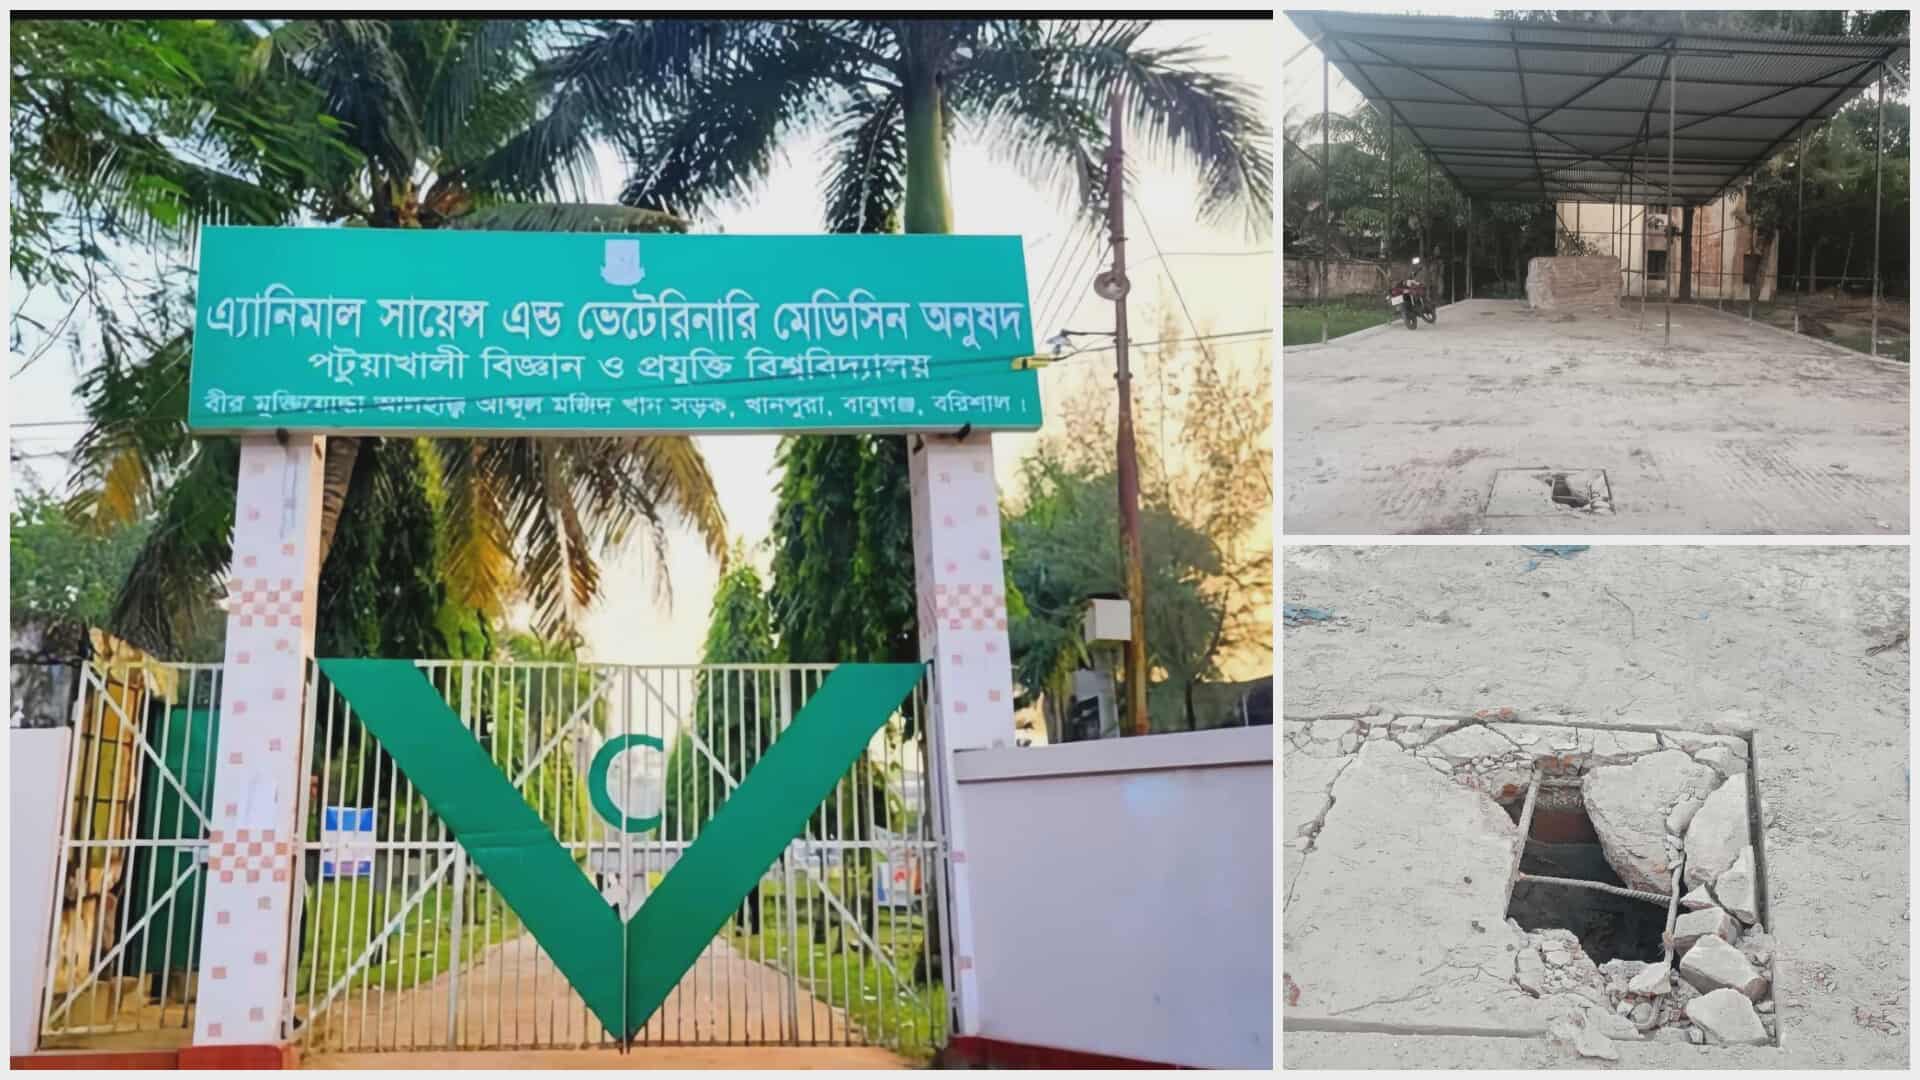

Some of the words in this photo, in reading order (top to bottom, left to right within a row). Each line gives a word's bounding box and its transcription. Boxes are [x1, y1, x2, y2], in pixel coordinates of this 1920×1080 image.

[207, 283, 367, 338] এ্যানিমাল
[376, 296, 489, 339] সায়েন্স
[502, 301, 565, 340] এন্ড
[578, 288, 760, 340] ভেটেরিনারি
[773, 288, 911, 341] মেডিসিন
[919, 302, 1024, 349] অনুষদ
[308, 344, 470, 385] পটুয়াখালী
[480, 346, 587, 380] বিজ্ঞান
[599, 356, 625, 379] ও
[637, 347, 735, 385] প্রযুক্তি
[744, 346, 932, 381] বিশ্ববিদ্যালয়
[204, 388, 246, 413] বীর
[670, 396, 736, 419] সড়ক,
[744, 396, 833, 418] খানপুরা,
[930, 390, 1011, 413] বরিশাল
